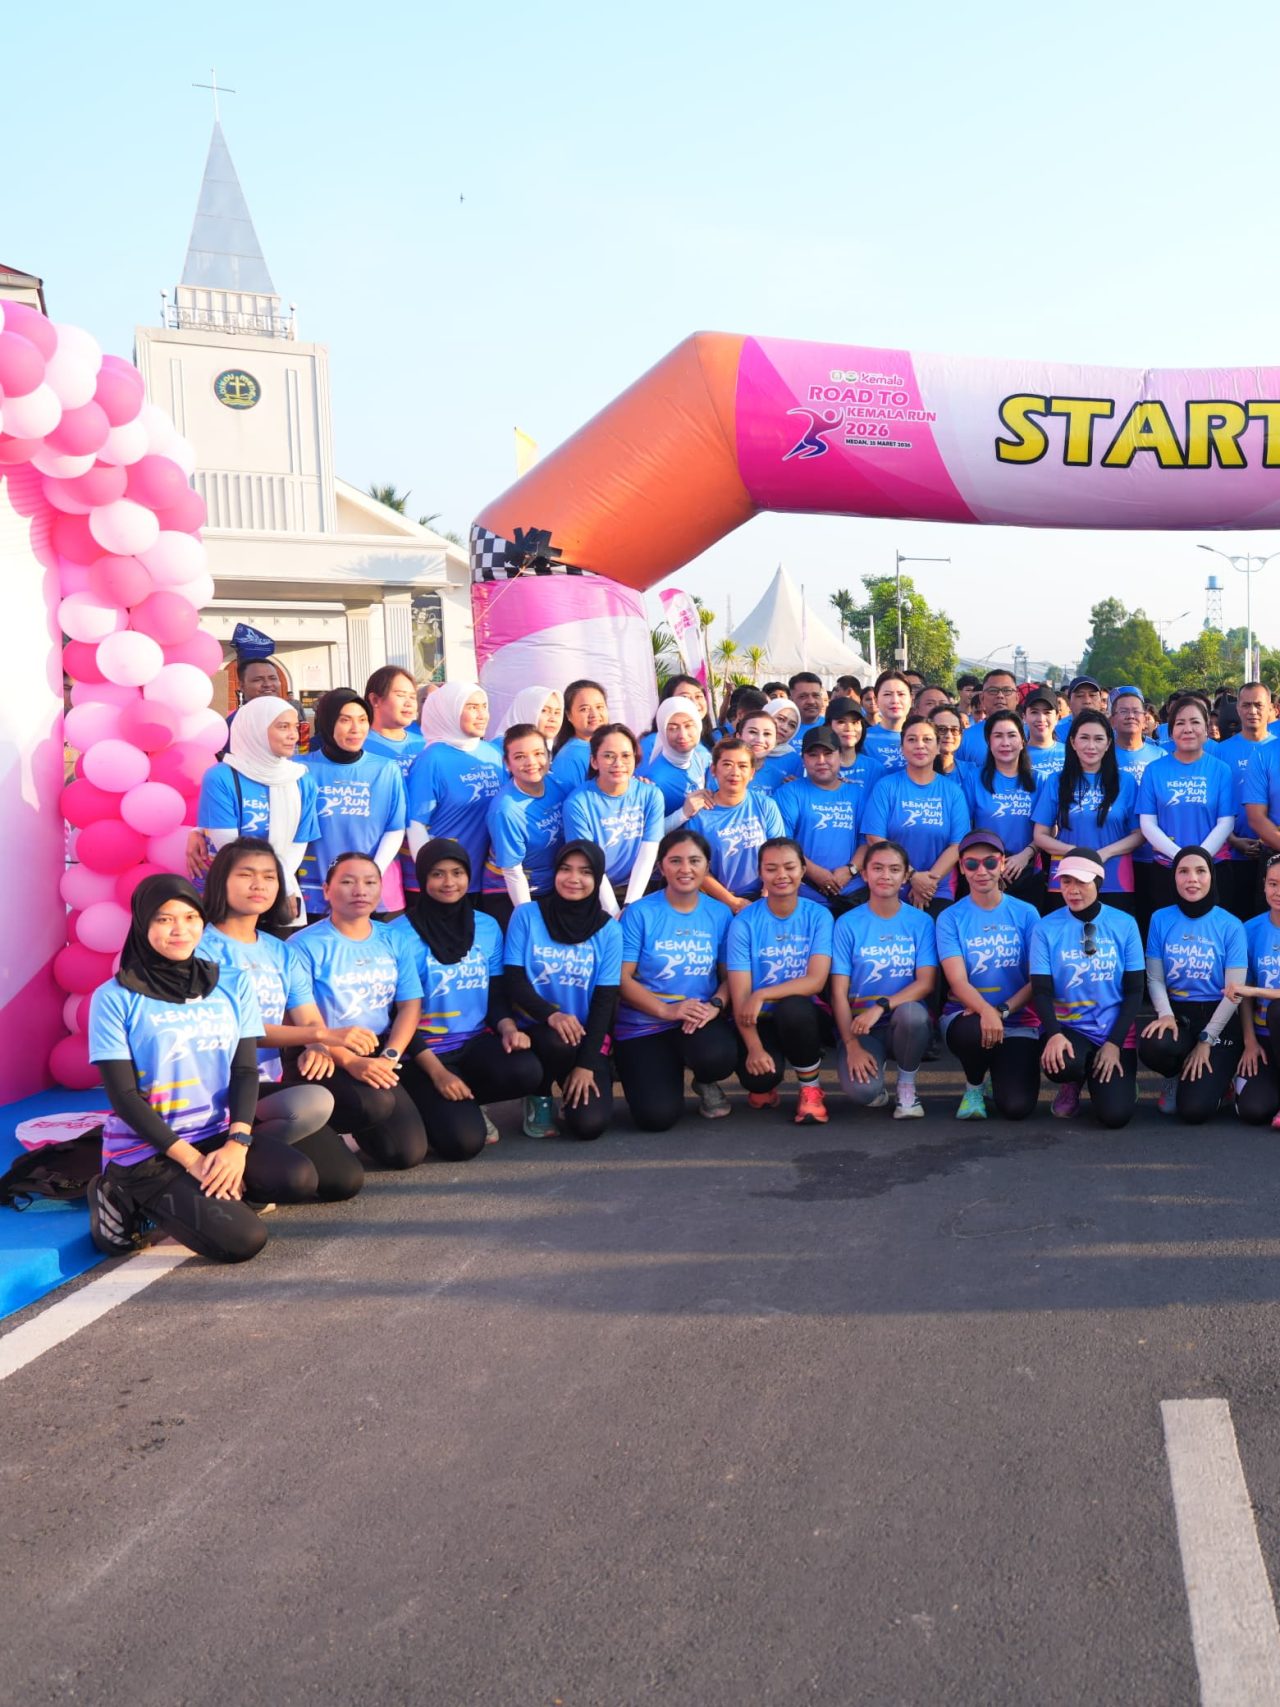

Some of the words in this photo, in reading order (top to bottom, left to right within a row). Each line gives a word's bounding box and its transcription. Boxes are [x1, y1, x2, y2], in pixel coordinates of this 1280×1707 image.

[809, 386, 873, 403] ROAD
[878, 391, 909, 406] TO
[847, 407, 904, 420] KEMALA
[907, 411, 937, 422] RUN
[846, 423, 889, 437] 2026
[1031, 760, 1064, 771] KEMAL
[1167, 780, 1207, 789] KEMALA
[316, 785, 370, 797] KEMALA
[1187, 787, 1207, 796] RUN
[344, 797, 370, 807] RUN
[992, 793, 1032, 802] KEMALA
[1185, 795, 1207, 804] 2026
[811, 803, 853, 813] KEMALA
[901, 800, 942, 811] KEMALA
[1013, 800, 1032, 808] RUN
[340, 807, 371, 817] 2026
[834, 812, 853, 821] RUN
[924, 809, 942, 817] RUN
[922, 817, 943, 826] 2026
[655, 939, 713, 953] KEMALA
[966, 933, 1021, 948] KEMALA
[533, 944, 595, 964] KEMALA
[860, 943, 916, 958] KEMALA
[998, 945, 1021, 958] RUN
[1165, 943, 1215, 960] KEMALA
[686, 951, 714, 965] RUN
[891, 955, 915, 968] RUN
[1188, 956, 1214, 970] RUN
[566, 960, 593, 977] RUN
[1092, 959, 1117, 971] RUN
[459, 965, 486, 978] RUN
[889, 967, 913, 978] 202
[456, 977, 488, 991] 2026
